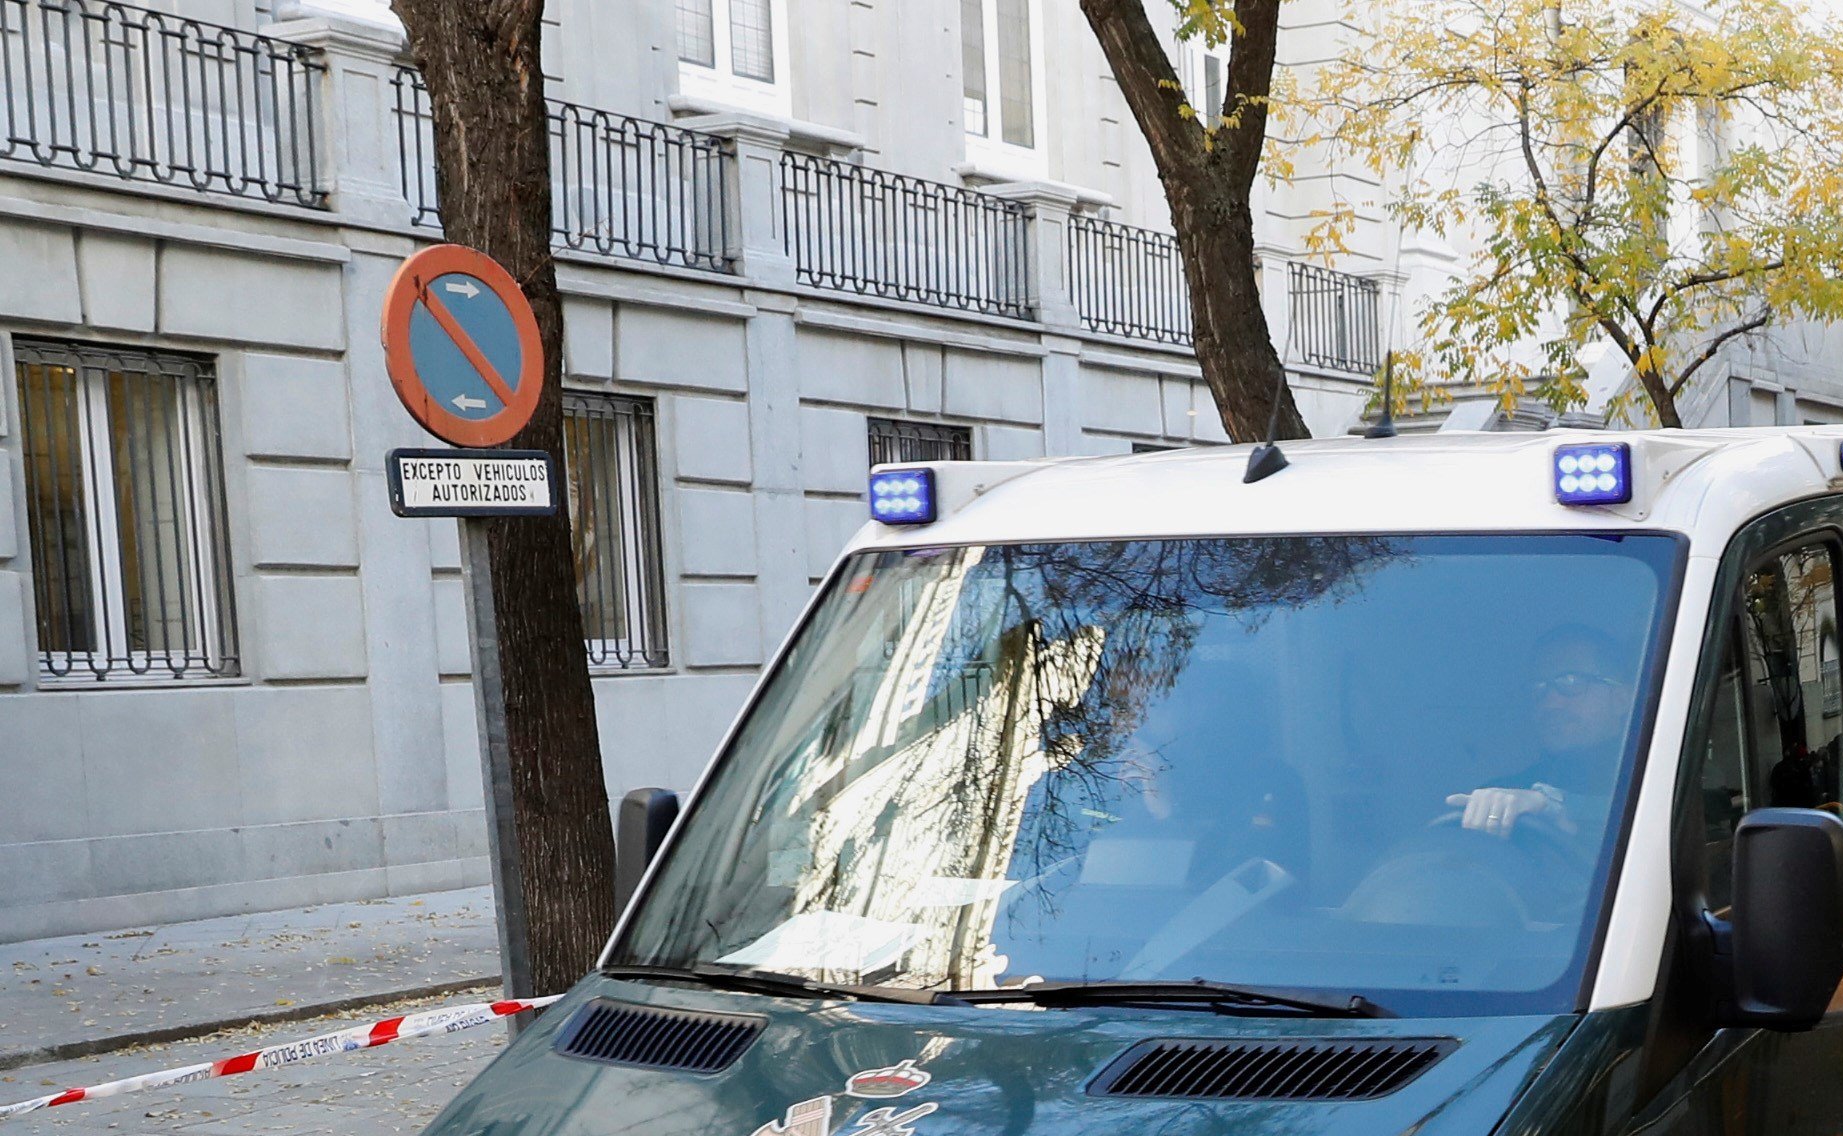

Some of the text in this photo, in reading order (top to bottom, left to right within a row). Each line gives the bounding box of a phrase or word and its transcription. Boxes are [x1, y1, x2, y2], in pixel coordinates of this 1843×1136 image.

[402, 462, 546, 482] EXCEPTO VEHICULOS
[432, 483, 527, 502] AUTORIZADOS
[301, 1041, 313, 1059] DE
